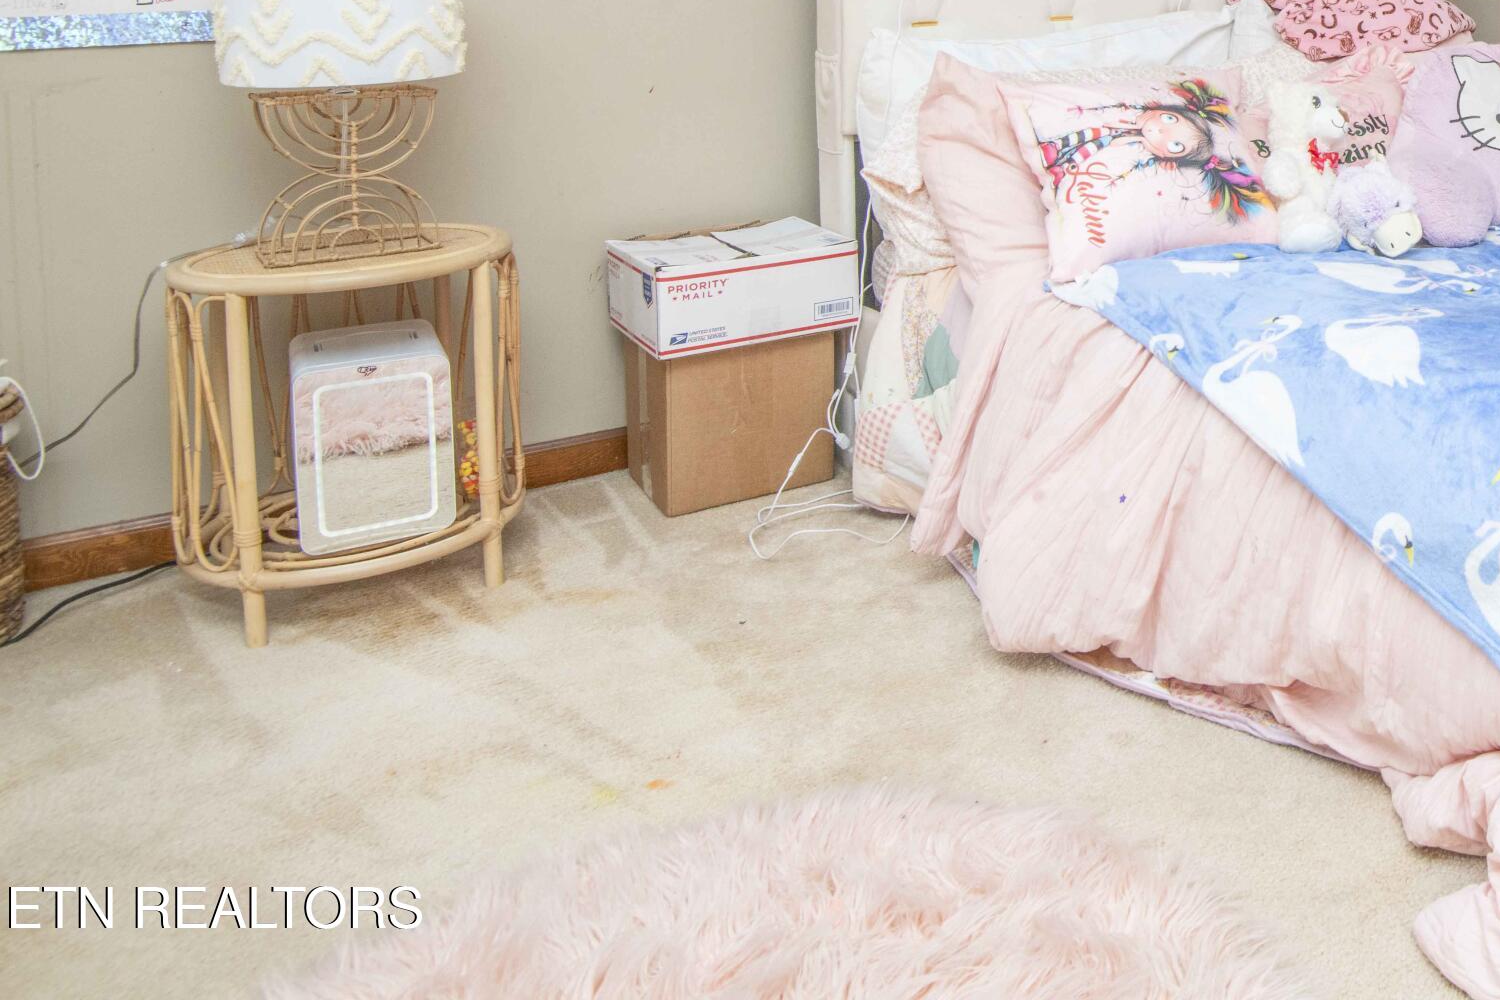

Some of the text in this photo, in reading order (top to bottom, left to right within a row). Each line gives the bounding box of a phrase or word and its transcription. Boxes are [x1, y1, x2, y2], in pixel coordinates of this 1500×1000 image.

[668, 279, 727, 294] PRIORITY
[682, 291, 713, 301] MAIL
[688, 326, 726, 336] UNITED STATES
[688, 333, 706, 343] POSTAL
